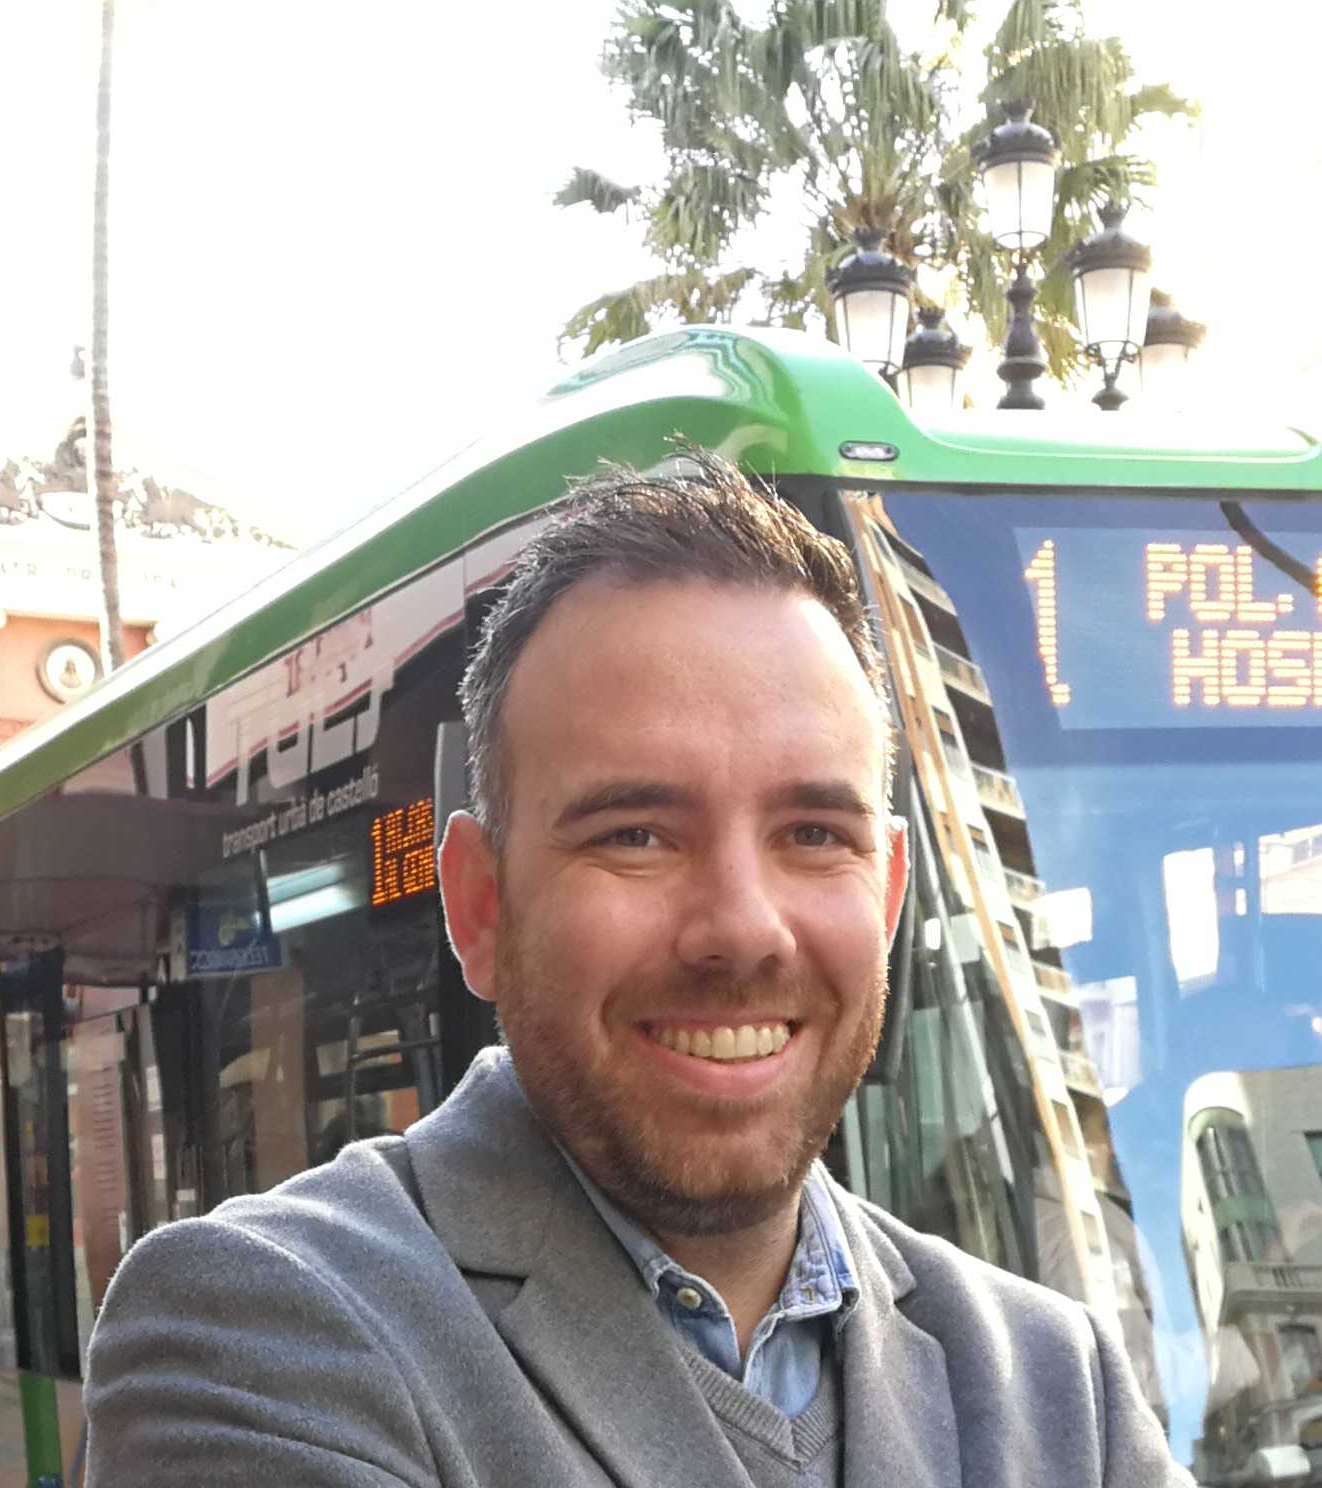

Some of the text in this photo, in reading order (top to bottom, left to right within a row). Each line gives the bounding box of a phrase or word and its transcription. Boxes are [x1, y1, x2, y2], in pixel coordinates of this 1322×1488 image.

[1145, 542, 1295, 623] POL.
[222, 811, 277, 858] transport
[309, 789, 326, 824] de
